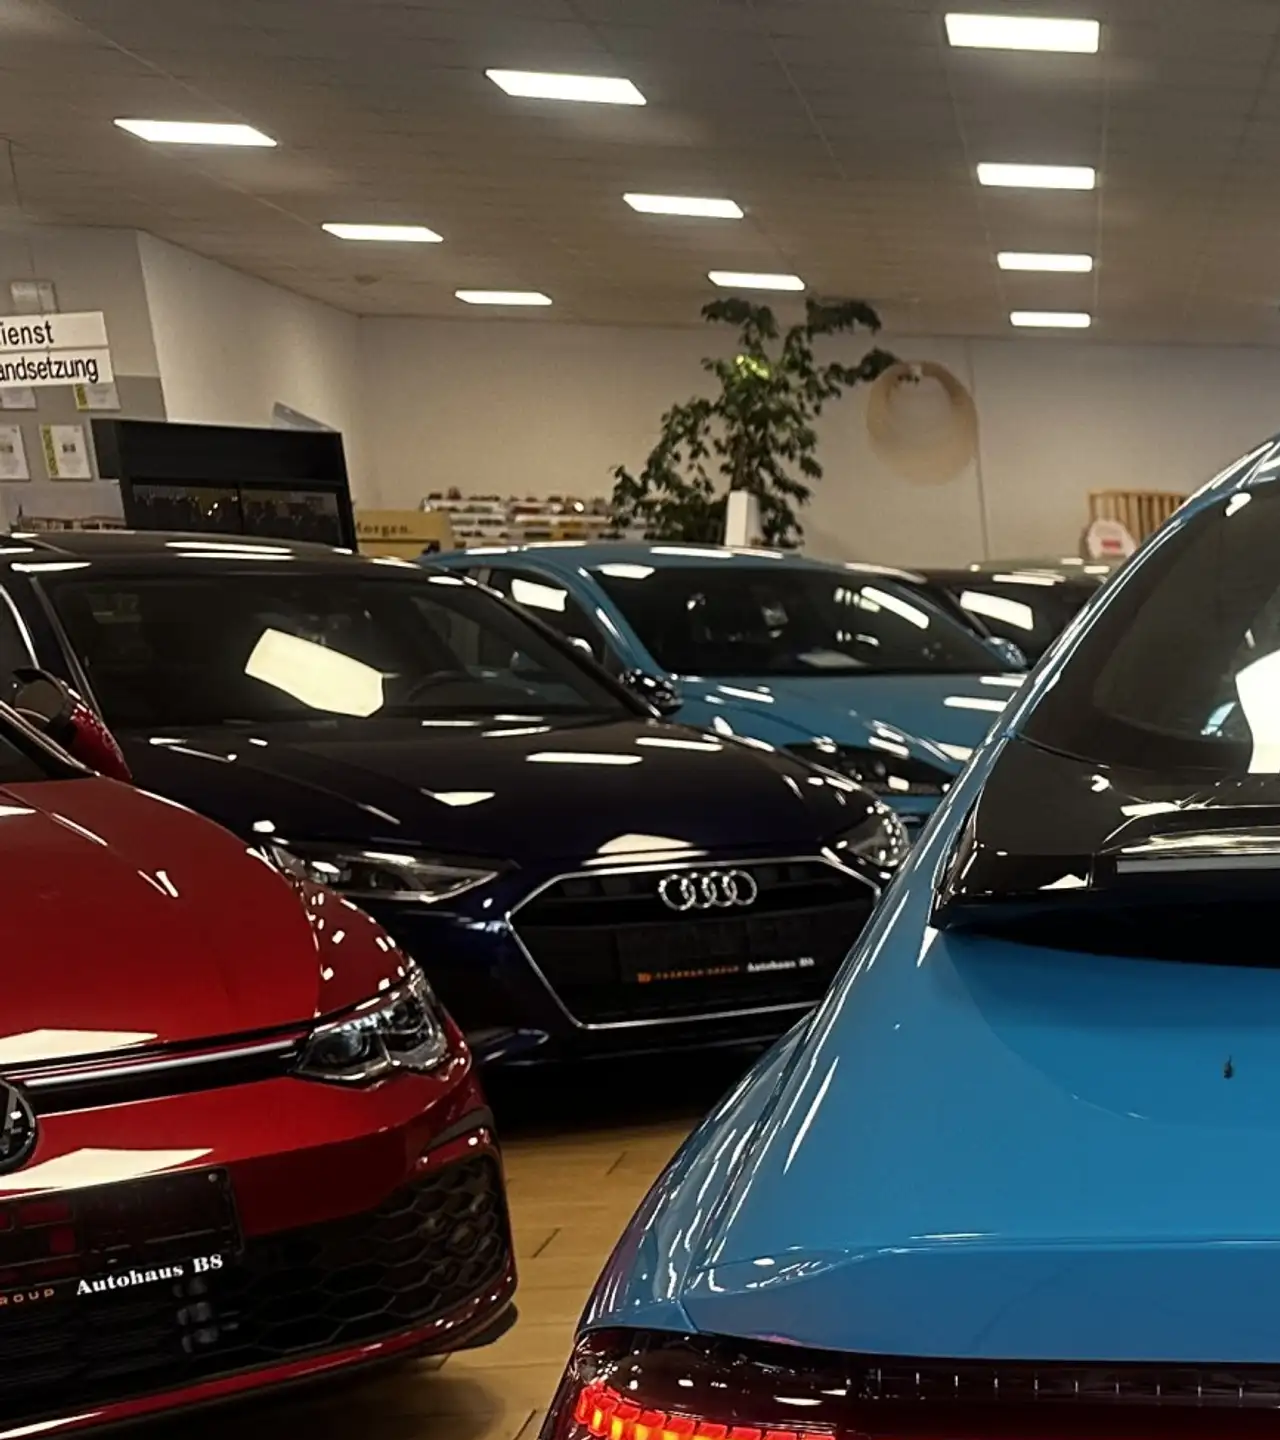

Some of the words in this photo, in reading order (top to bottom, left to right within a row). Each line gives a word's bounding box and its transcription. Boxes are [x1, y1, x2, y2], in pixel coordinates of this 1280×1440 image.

[0, 320, 54, 346] ienst
[76, 1264, 184, 1296] Autohaus
[193, 1253, 224, 1274] B8
